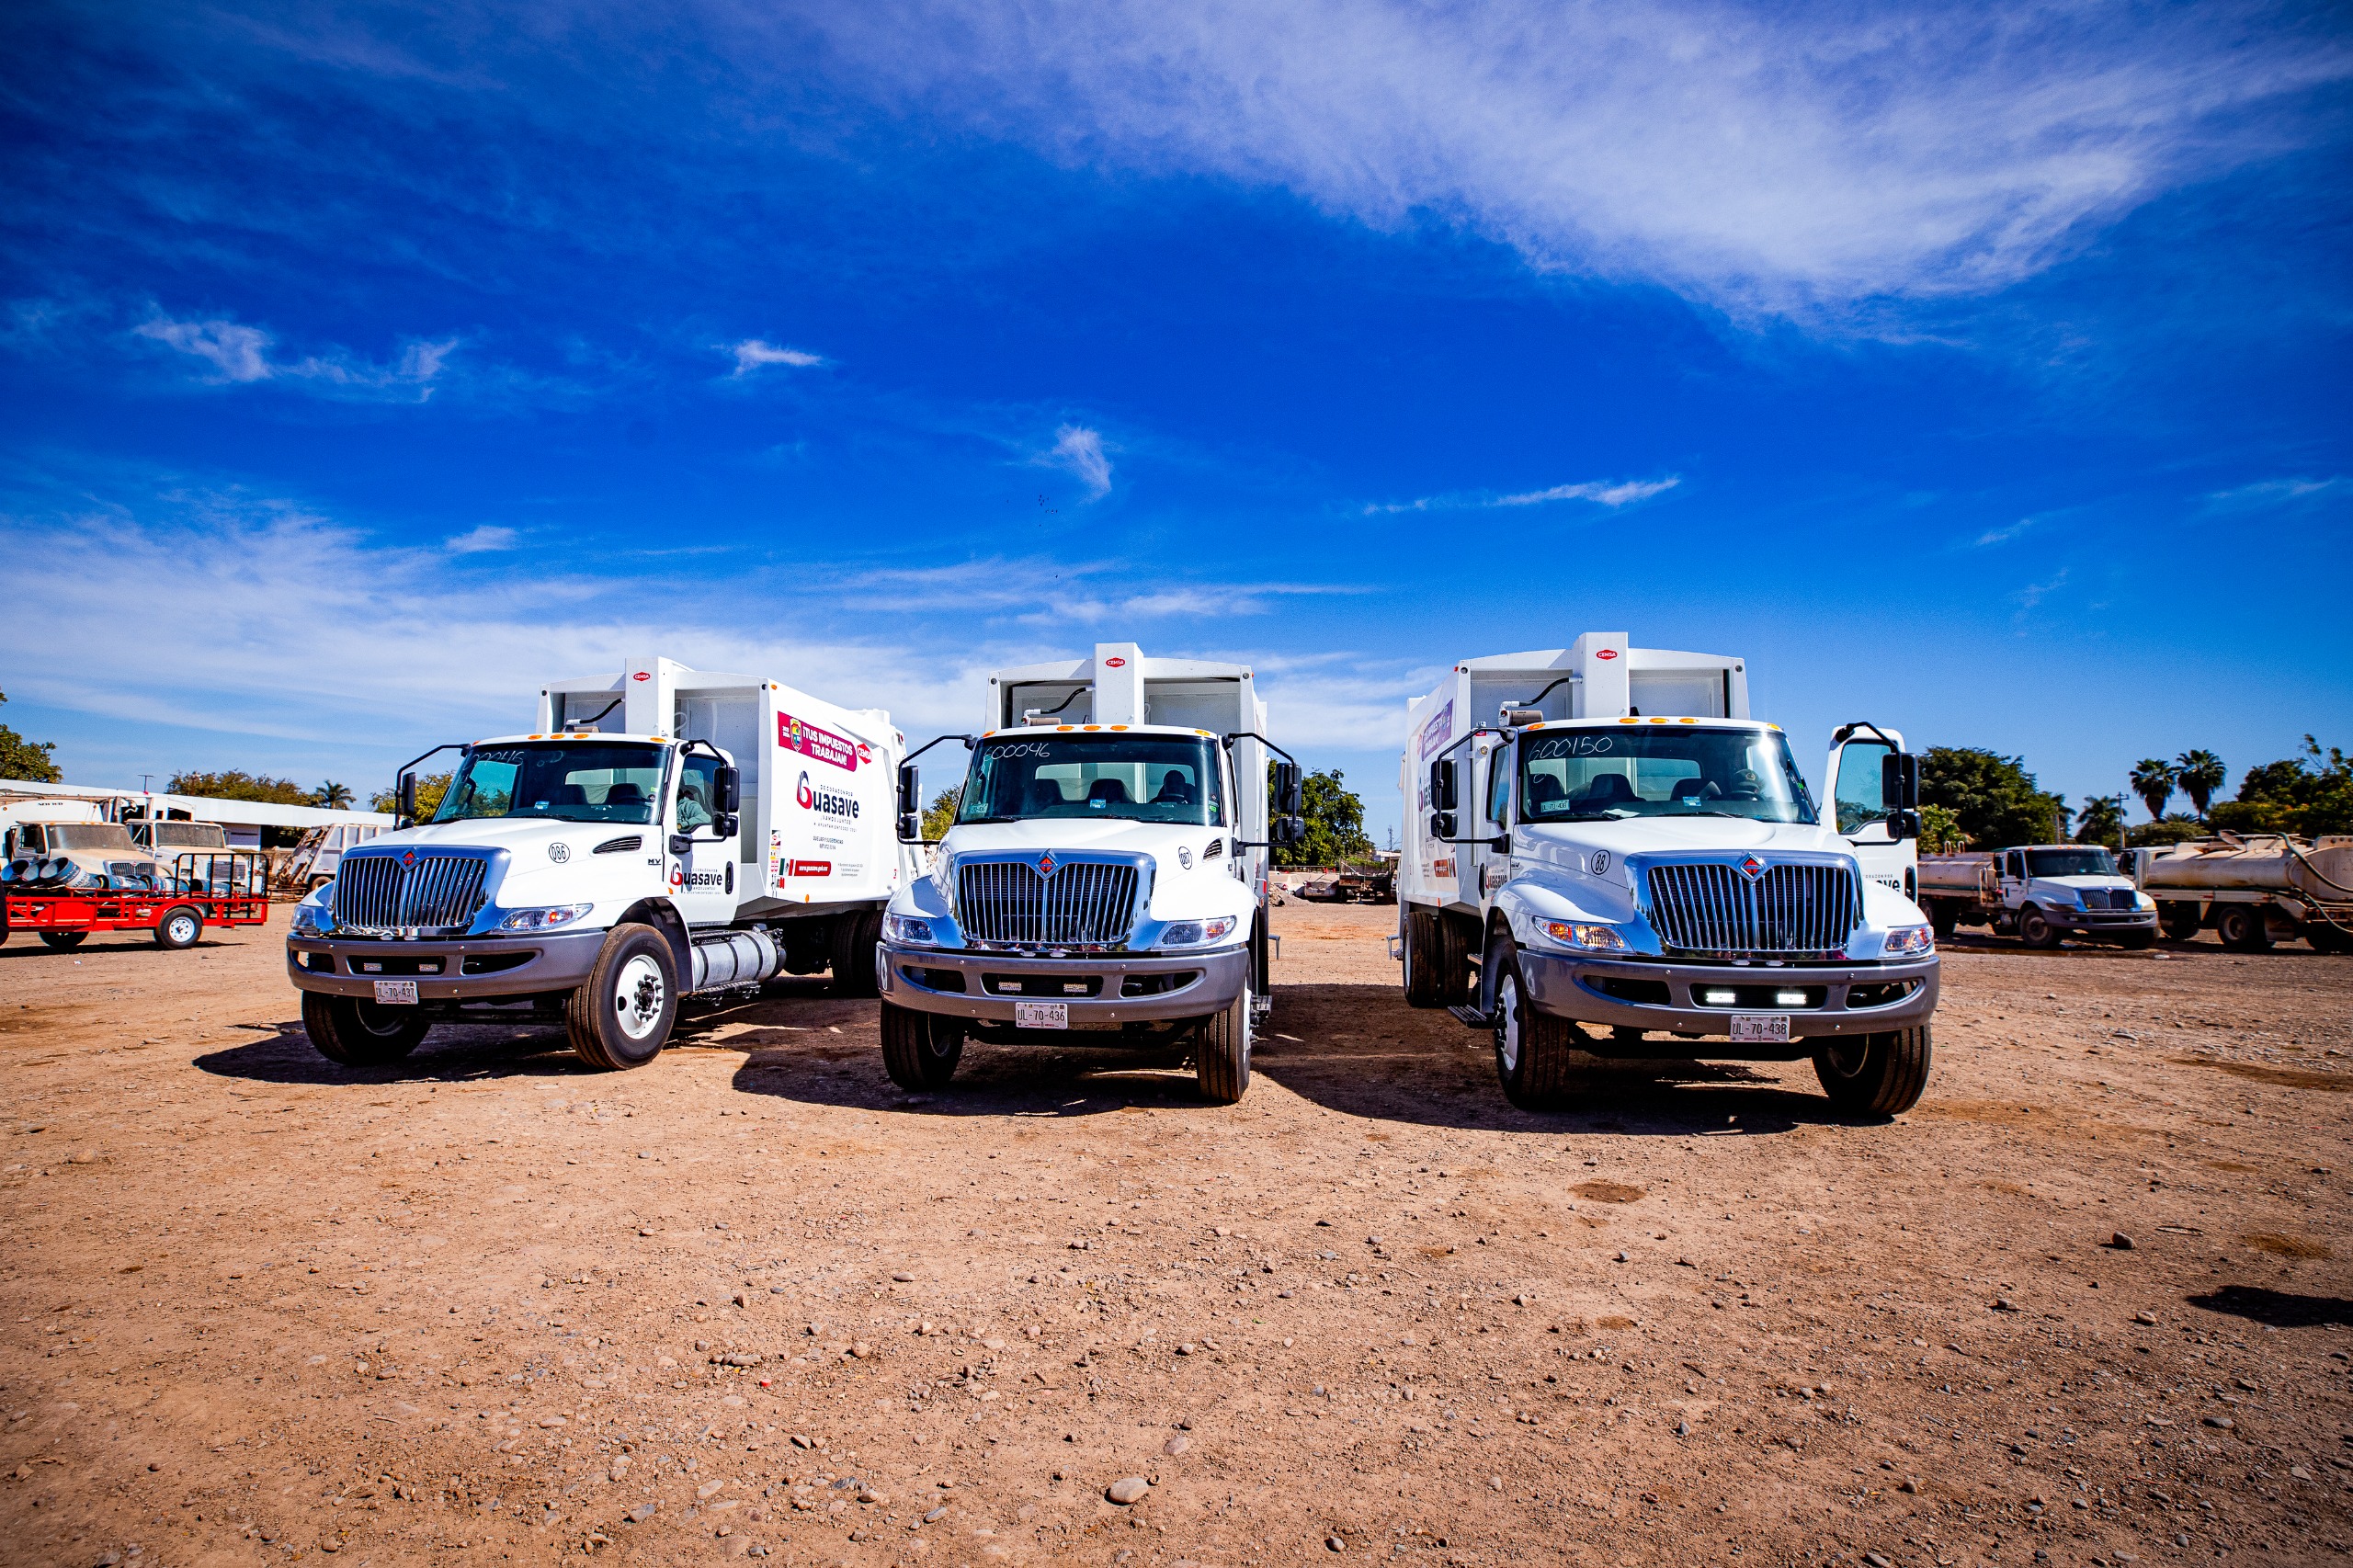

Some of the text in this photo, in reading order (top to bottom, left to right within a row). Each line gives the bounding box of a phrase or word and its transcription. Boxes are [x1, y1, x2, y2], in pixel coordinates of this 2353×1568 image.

[818, 732, 853, 756] IMPUESTOS
[811, 743, 847, 766] TRABAJAN!
[551, 846, 566, 860] 086
[1596, 854, 1606, 871] 88
[377, 987, 415, 997] UL-70-437
[1017, 1009, 1065, 1021] UL-70-436
[1733, 1023, 1787, 1035] UL-70-438
